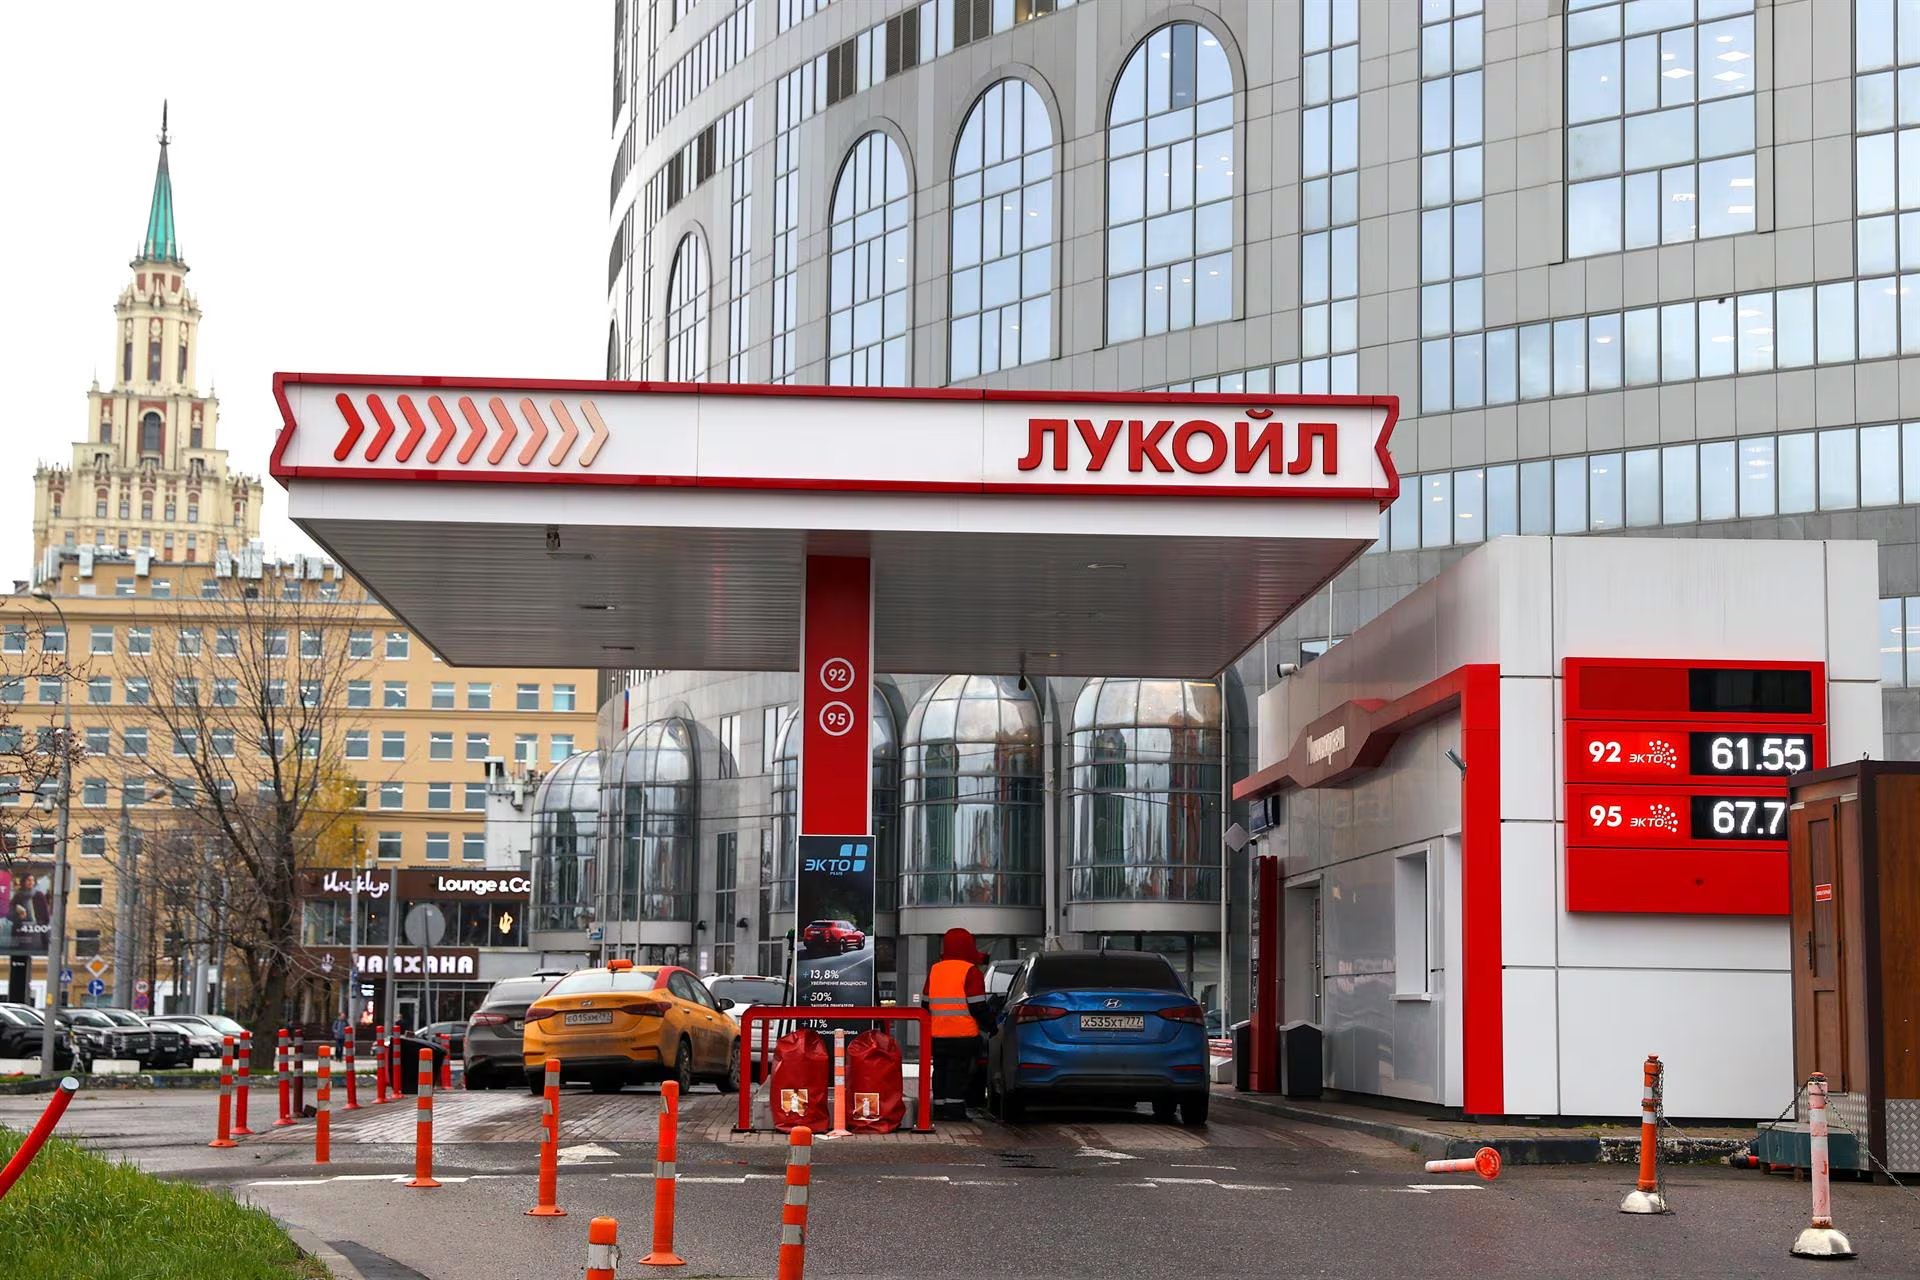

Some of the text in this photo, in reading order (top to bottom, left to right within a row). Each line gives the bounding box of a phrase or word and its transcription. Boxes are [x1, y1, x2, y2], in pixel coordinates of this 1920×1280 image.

[1017, 408, 1338, 475] ЛУКОЙЛ
[828, 668, 846, 681] 92
[827, 712, 846, 726] 95
[1588, 741, 1664, 763] 92 ЭКТО
[1711, 736, 1807, 771] 61.55
[1589, 805, 1665, 828] 95 ЭКТО
[804, 858, 851, 872] ЭКТО
[438, 876, 498, 895] Lounge
